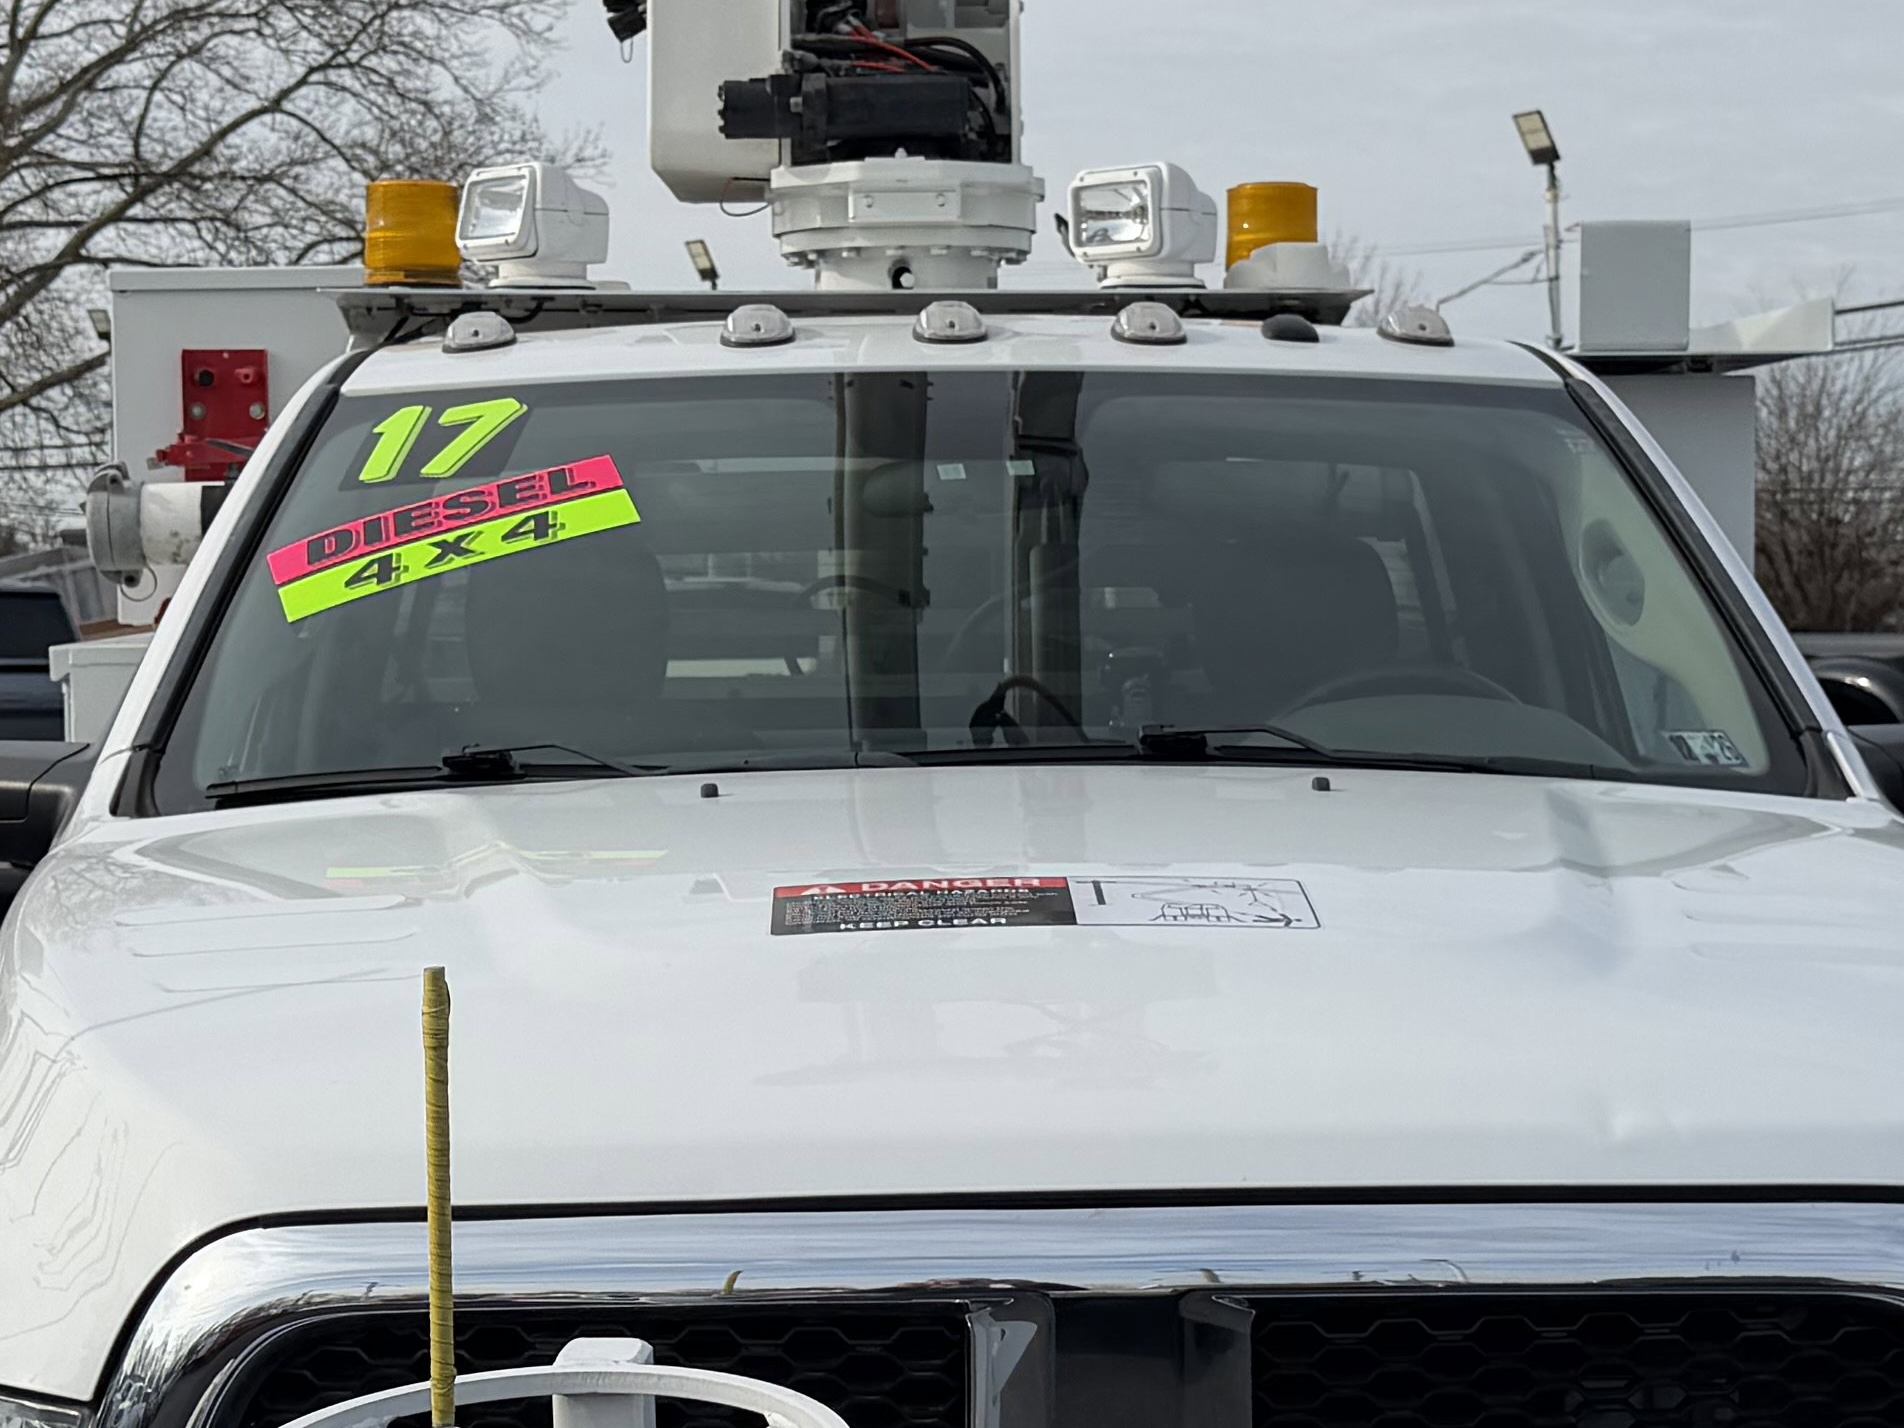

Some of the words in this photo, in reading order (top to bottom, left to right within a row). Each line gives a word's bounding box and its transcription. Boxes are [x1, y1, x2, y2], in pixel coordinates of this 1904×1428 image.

[359, 397, 528, 483] 17
[307, 466, 596, 566] DIESEL
[861, 877, 1041, 892] DANGER
[839, 919, 909, 930] KEEP
[917, 917, 1007, 927] CLEAR
